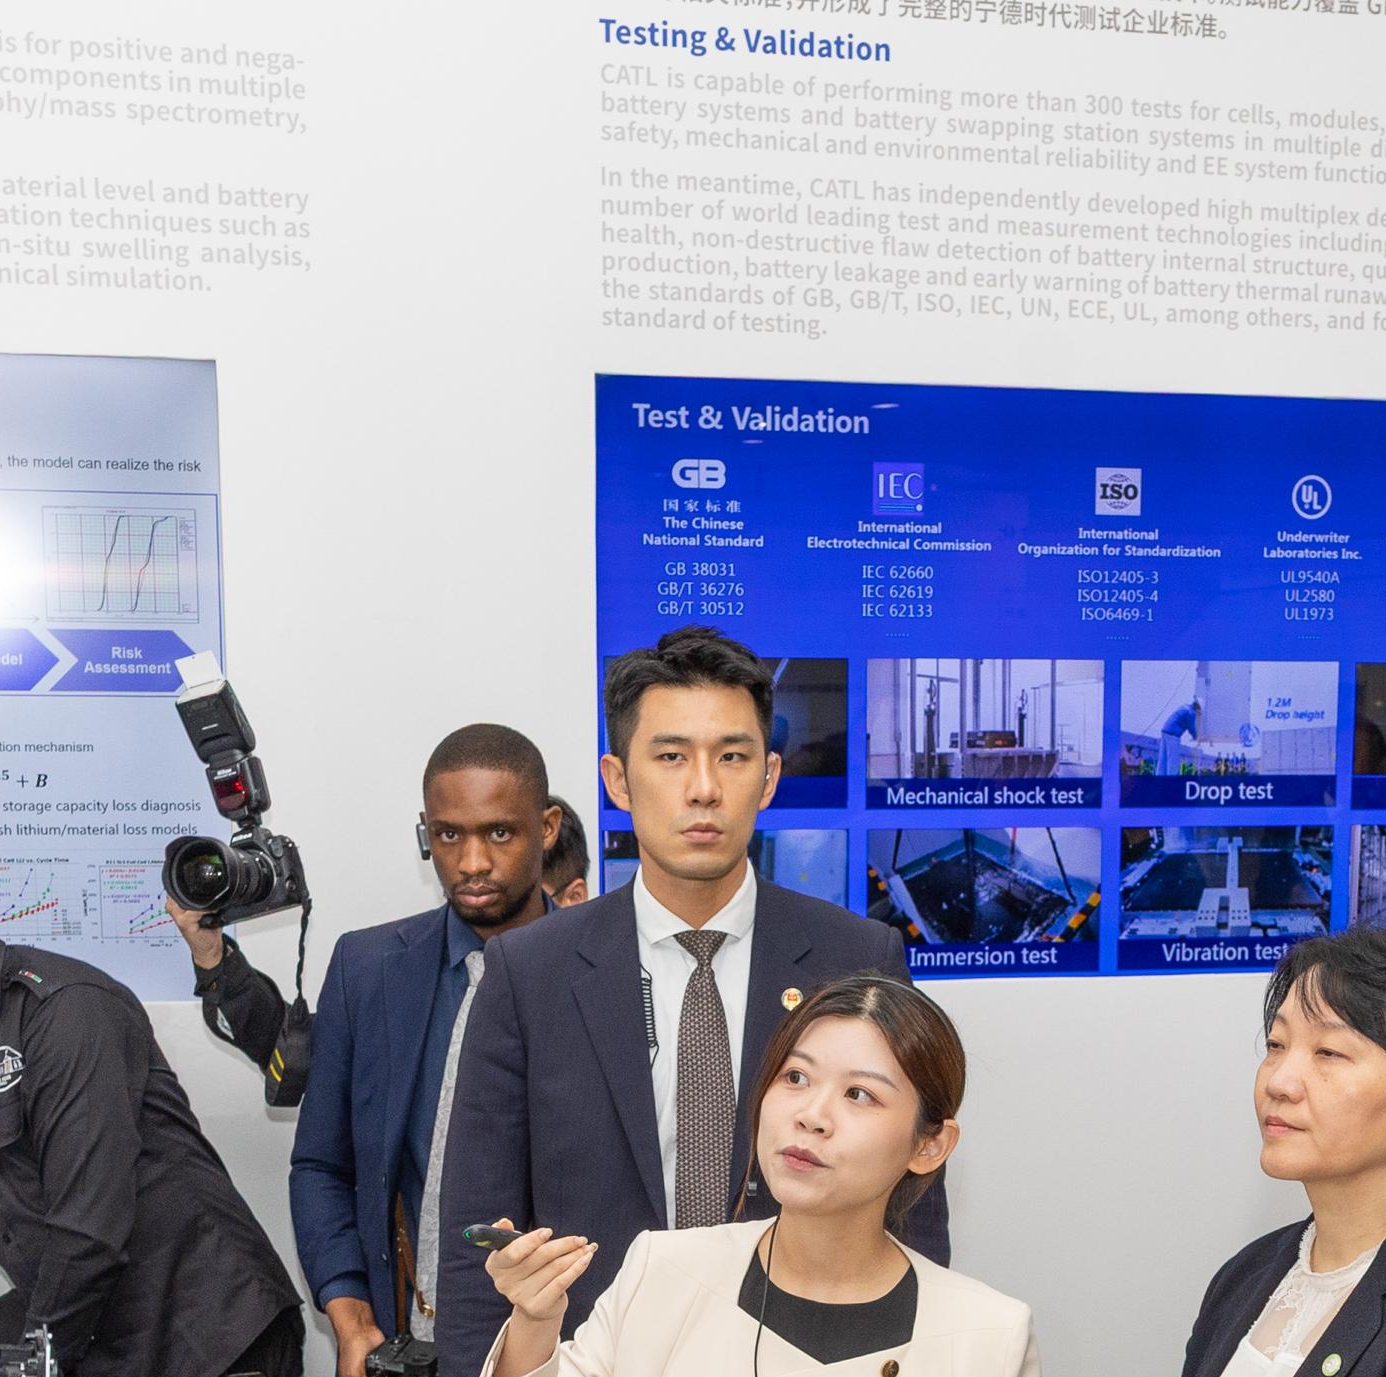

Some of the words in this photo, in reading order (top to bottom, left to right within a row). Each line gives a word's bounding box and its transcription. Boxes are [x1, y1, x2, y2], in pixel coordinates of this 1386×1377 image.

[598, 18, 707, 57] Testing
[714, 26, 736, 52] &
[743, 28, 891, 62] Validation
[600, 63, 659, 94] CATL
[667, 66, 686, 89] is
[693, 71, 785, 97] capable
[792, 75, 817, 97] of
[824, 78, 953, 112] performing
[960, 91, 1019, 110] more
[1026, 89, 1077, 113] than
[1084, 94, 1124, 116] 300
[1130, 98, 1182, 120] tests
[1189, 99, 1221, 122] for
[1227, 103, 1281, 131] cells,
[1289, 108, 1386, 137] modules,
[66, 264, 212, 292] simulation.
[602, 307, 706, 330] standard
[712, 313, 736, 331] of
[740, 314, 827, 341] testing.
[632, 402, 690, 429] Test
[697, 405, 724, 430] &
[731, 405, 870, 434] Validation
[671, 458, 726, 489] GB
[878, 472, 923, 499] IEC
[1099, 482, 1139, 501] ISO
[663, 498, 741, 514] 国家标准
[662, 516, 689, 529] The
[691, 516, 745, 530] Chinese
[857, 520, 942, 534] International
[642, 533, 700, 546] National
[704, 534, 764, 548] Standard
[1078, 527, 1159, 541] International
[1277, 530, 1350, 544] Underwriter
[807, 536, 910, 550] Electrotechnical
[913, 538, 992, 552] Commission
[1017, 542, 1099, 558] Organization
[1102, 543, 1121, 556] for
[1124, 544, 1222, 558] Standardization
[1263, 546, 1339, 560] Laboratories
[1341, 547, 1363, 560] Inc.
[664, 561, 687, 576] GB
[692, 562, 736, 577] 38031
[862, 564, 885, 579] IEC
[889, 565, 934, 580] 62660
[1077, 569, 1159, 584] ISO12405-3
[1280, 570, 1340, 584] UL9540A
[657, 581, 694, 598] GB/T
[700, 582, 745, 597] 36276
[862, 584, 885, 598] IEC
[889, 584, 934, 599] 62619
[1077, 588, 1159, 603] ISO12405-4
[1285, 588, 1335, 603] UL2580
[657, 600, 694, 617] GB/T
[700, 601, 744, 616] 30512
[862, 603, 885, 617] IEC
[889, 603, 933, 618] 62133
[1081, 607, 1153, 622] ISO6469-1
[1284, 607, 1334, 621] UL1973
[111, 646, 143, 659] Risk
[83, 660, 172, 674] Assessment
[887, 786, 989, 805] Mechanical
[993, 785, 1046, 805] shock
[1050, 787, 1084, 805] test
[1185, 781, 1233, 804] Drop
[1238, 782, 1274, 800] test
[2, 801, 52, 815] storage
[55, 801, 109, 815] capacity
[112, 799, 138, 812] loss
[140, 799, 201, 815] diagnosis
[909, 945, 1016, 967] Immersion
[1020, 946, 1058, 965] test
[1162, 941, 1249, 962] Vibration
